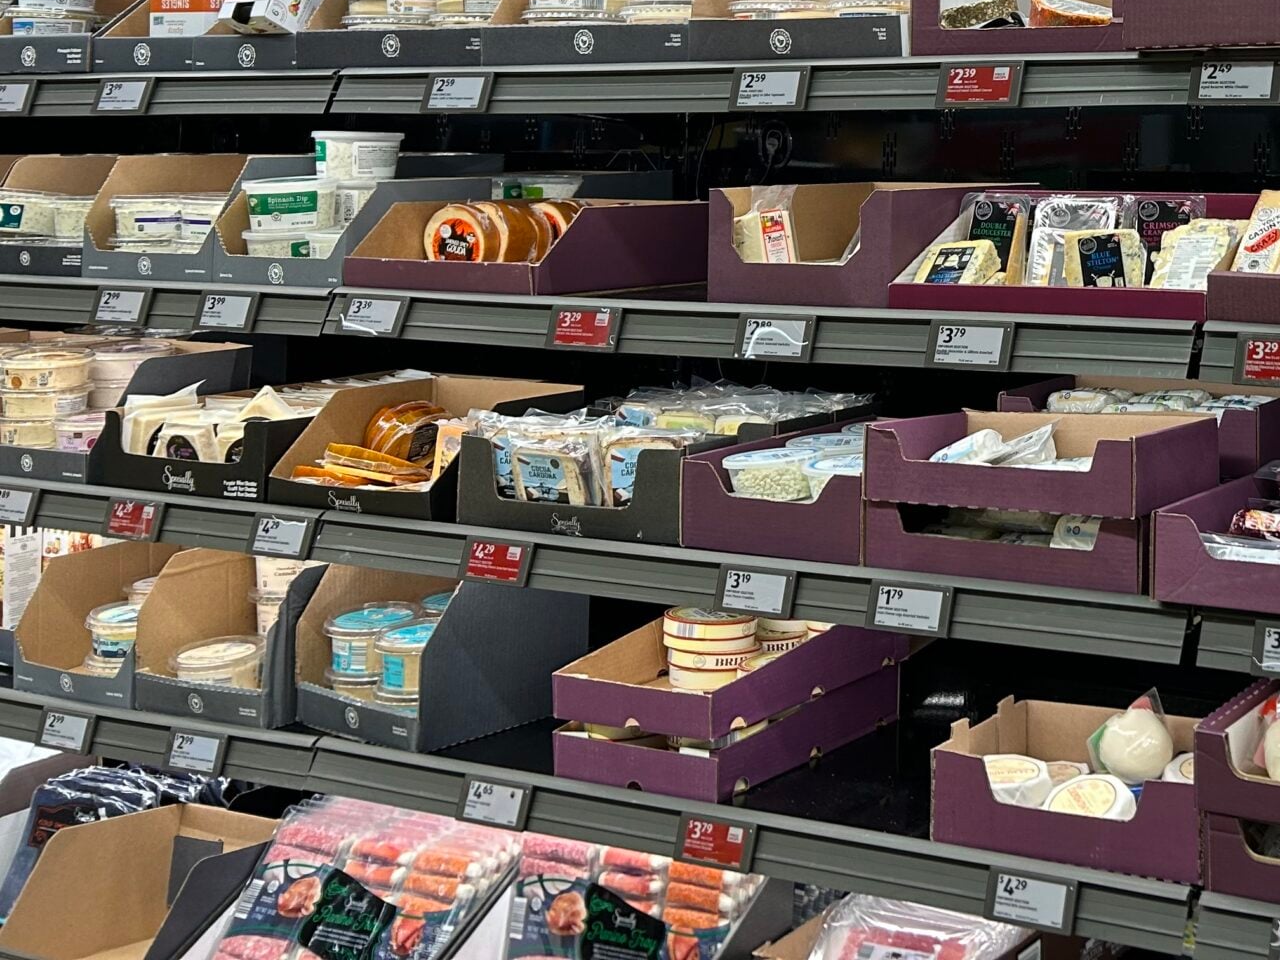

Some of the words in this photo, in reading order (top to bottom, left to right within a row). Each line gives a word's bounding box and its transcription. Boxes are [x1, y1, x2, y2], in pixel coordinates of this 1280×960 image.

[296, 195, 309, 204] Dip
[980, 221, 1007, 230] DOUBLE
[972, 228, 1012, 237] GLOUCESTER
[1248, 224, 1276, 241] CAJUN
[1250, 230, 1279, 252] CRAZY
[447, 245, 467, 257] GOUDA
[1091, 251, 1112, 259] BLUE
[531, 465, 551, 473] COCOA
